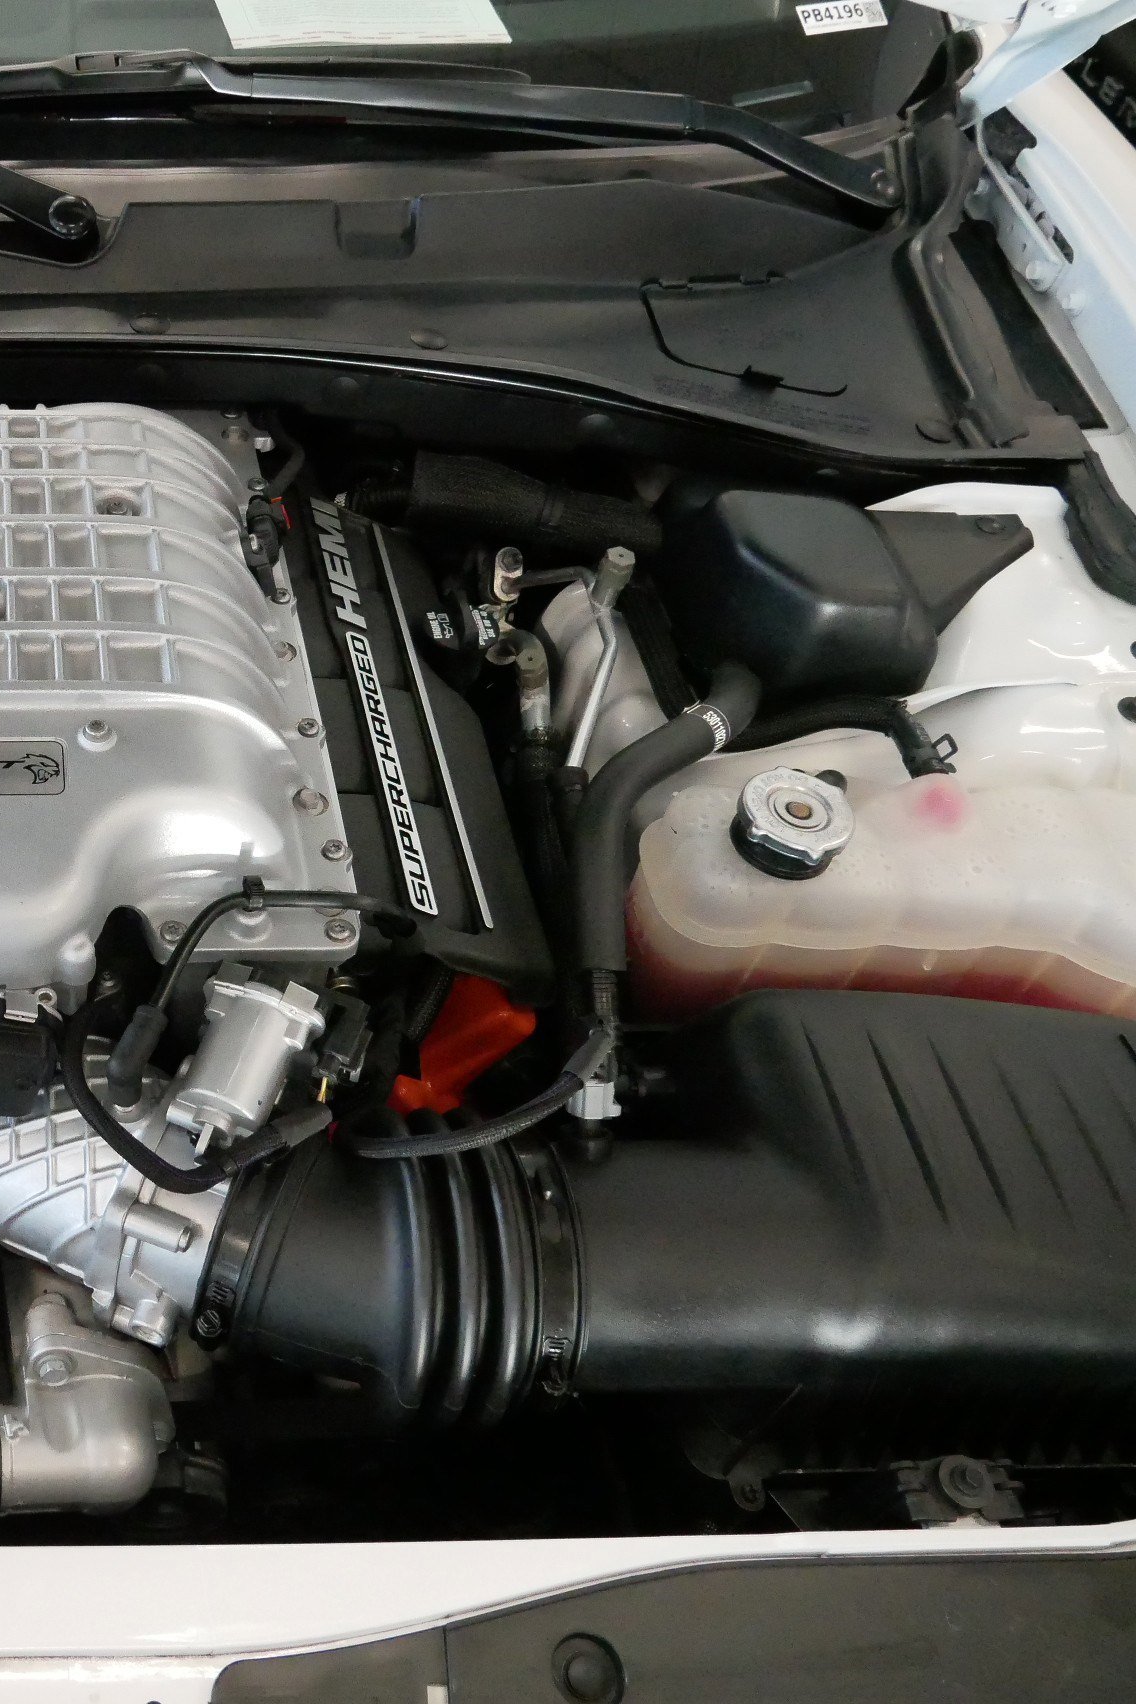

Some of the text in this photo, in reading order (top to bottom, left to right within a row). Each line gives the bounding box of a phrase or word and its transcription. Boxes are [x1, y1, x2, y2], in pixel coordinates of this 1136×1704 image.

[800, 3, 864, 24] PB4196
[310, 497, 436, 911] SUPERCHARGED HEMI
